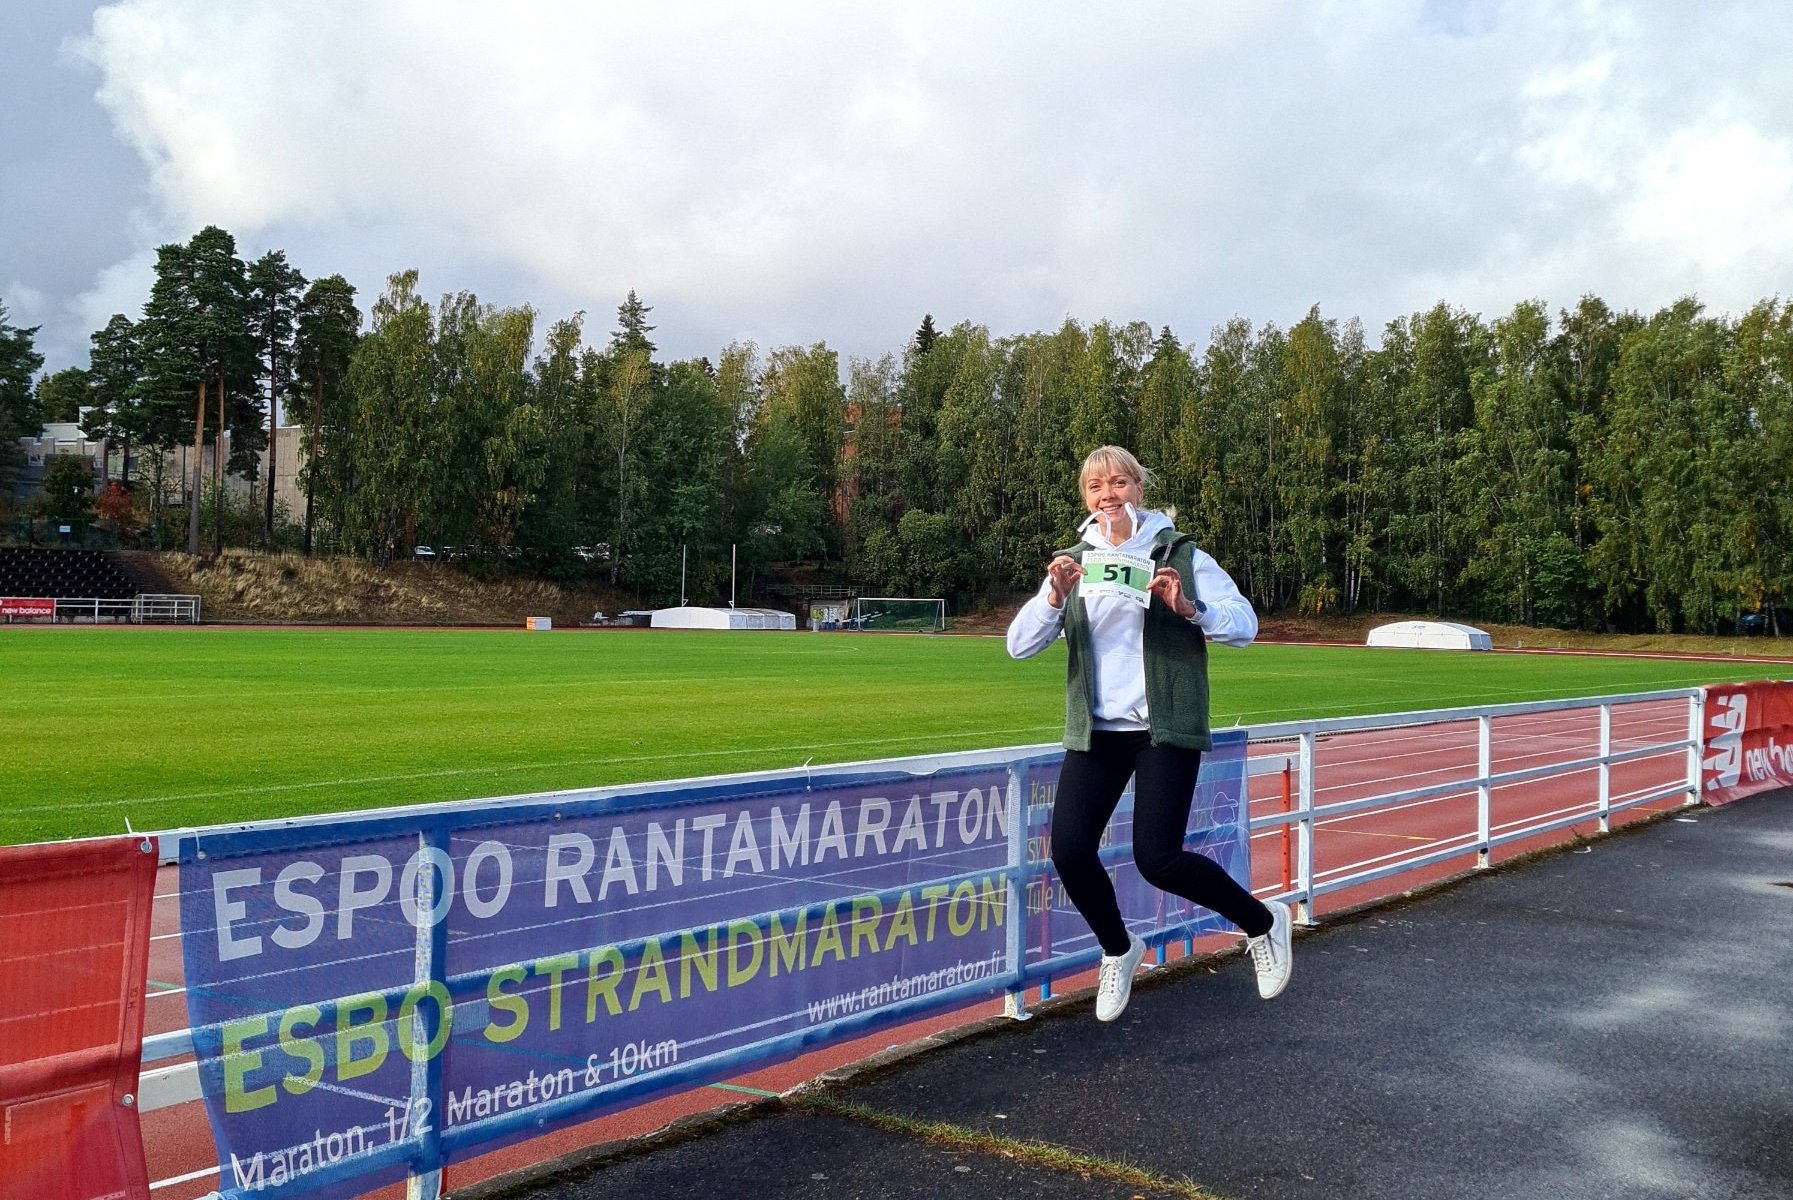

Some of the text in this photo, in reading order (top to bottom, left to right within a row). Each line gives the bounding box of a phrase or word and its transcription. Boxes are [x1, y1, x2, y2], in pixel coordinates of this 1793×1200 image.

[19, 606, 52, 615] balance
[1103, 564, 1131, 585] 51
[1746, 746, 1777, 782] new
[212, 784, 1009, 962] ESPOO RANTAMARATON
[221, 873, 1008, 1114] ESBO STRANDMARATON
[808, 950, 1001, 1023] www.rantamaraton.fi
[230, 1038, 679, 1192] Maraton, 1/2 Maraton & 10km
